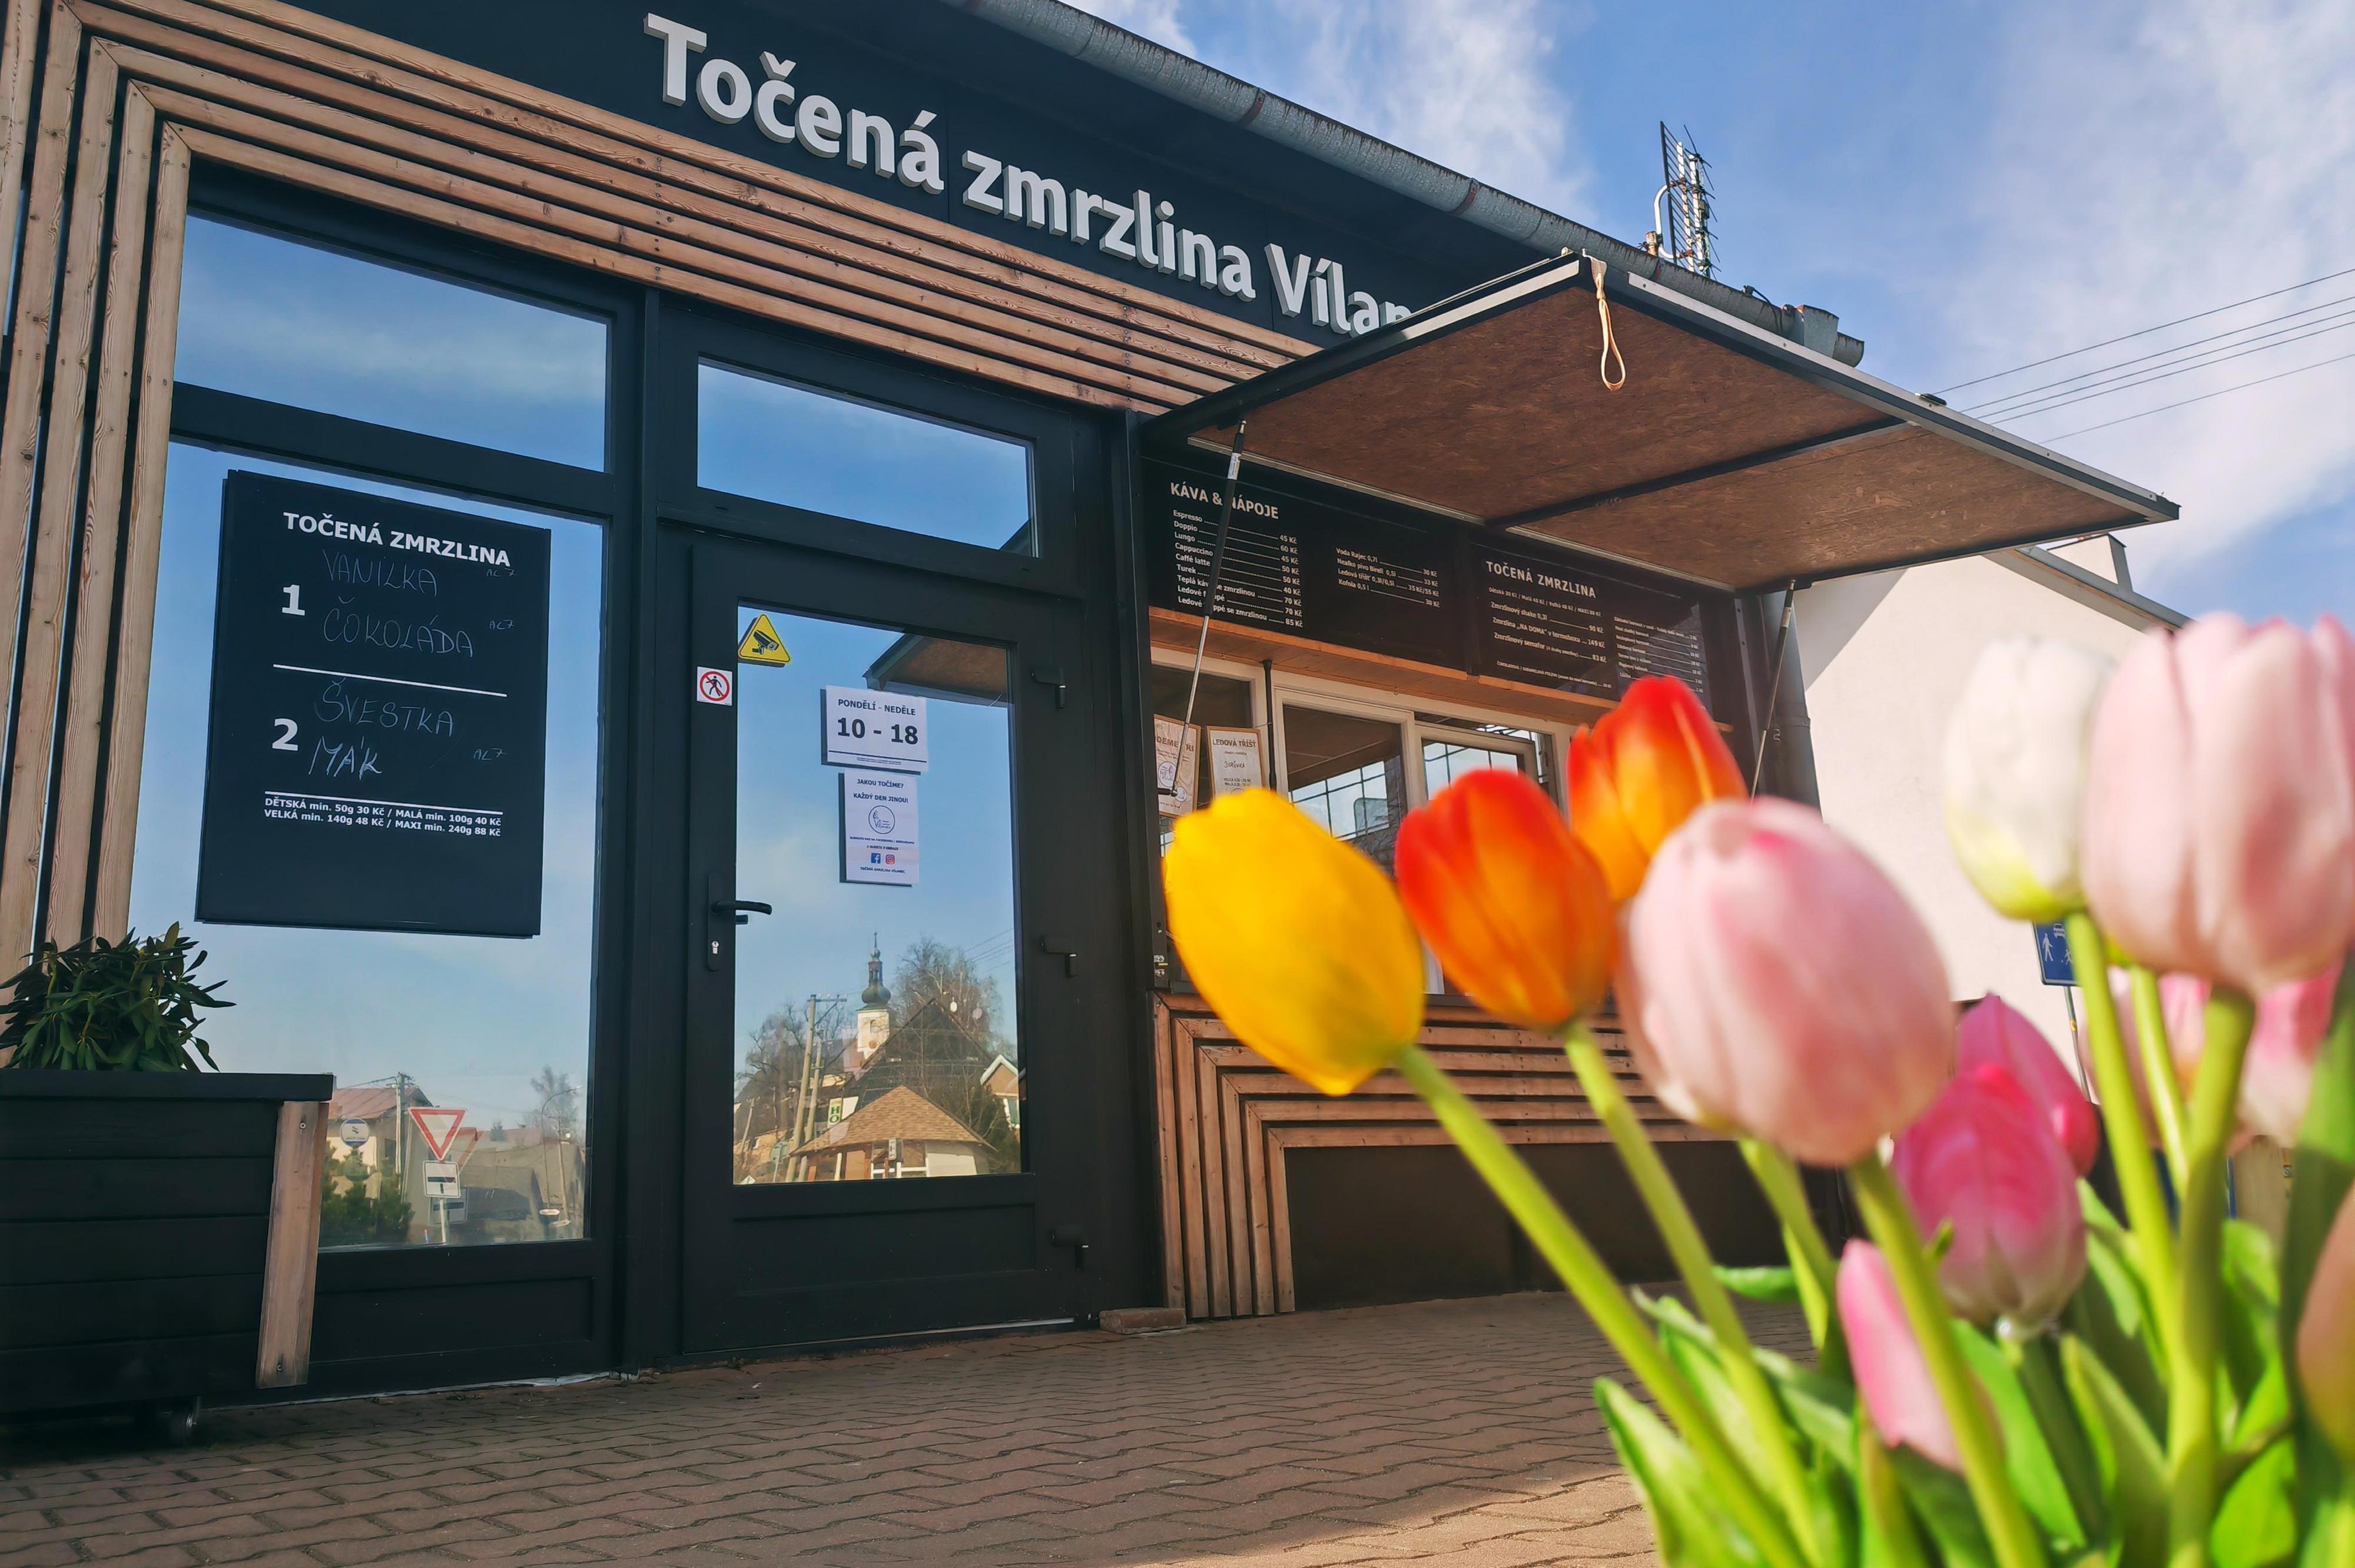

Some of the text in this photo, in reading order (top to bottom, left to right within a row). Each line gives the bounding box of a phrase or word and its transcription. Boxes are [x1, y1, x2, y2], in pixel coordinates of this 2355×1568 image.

[644, 13, 944, 195] Točená
[962, 150, 1256, 301] zmrzlina
[1170, 481, 1209, 502] KÁVA
[1212, 492, 1223, 506] &
[1173, 510, 1202, 522] Espresso
[1174, 521, 1198, 532] Doppio
[283, 512, 510, 567] TOČENÁ ZMRZLINA
[1175, 531, 1195, 542] Lungo
[1175, 542, 1213, 556] Cappuccino
[1195, 556, 1210, 566] latte
[1336, 547, 1350, 556] Voda
[323, 549, 437, 596] VANILKA
[1176, 563, 1197, 575] Turek
[1485, 561, 1596, 598] TOČENÁ ZMRZLINA
[1177, 575, 1196, 585] Teplá
[1223, 585, 1255, 597] zmrzlinou
[1178, 585, 1202, 596] Ledové
[1338, 578, 1356, 588] Kofola
[281, 584, 305, 616] 1
[1178, 595, 1202, 607] Ledové
[1236, 608, 1267, 621] zmrzlinou
[324, 595, 474, 657] ČOKOLÁDA
[314, 677, 453, 737] ŠVESTKA
[838, 698, 876, 710] PONDĚLÍ
[884, 705, 916, 715] NEDĚLE
[272, 718, 298, 751] 2
[837, 717, 865, 738] 10
[891, 724, 918, 744] 18
[1213, 738, 1237, 747] LEDOVÁ
[308, 735, 383, 780] MÁK
[878, 780, 904, 788] TOČÍME?
[264, 809, 298, 820] VELKÁ
[301, 813, 324, 821] min.
[327, 814, 353, 826] 140g
[355, 817, 369, 825] 48
[372, 818, 384, 827] Kč
[386, 819, 392, 828] /
[395, 820, 422, 830] MAXI
[424, 823, 446, 832] min.
[448, 825, 472, 836] 240g
[489, 828, 501, 837] Kč
[265, 797, 307, 809] DĚTSKÁ
[310, 801, 332, 811] min.
[335, 804, 354, 815] 50g
[372, 807, 384, 816] Kč
[387, 808, 393, 818] /
[396, 809, 423, 819] MALÁ
[425, 812, 446, 821] min.
[449, 814, 473, 825] 100g
[489, 817, 502, 826] Kč
